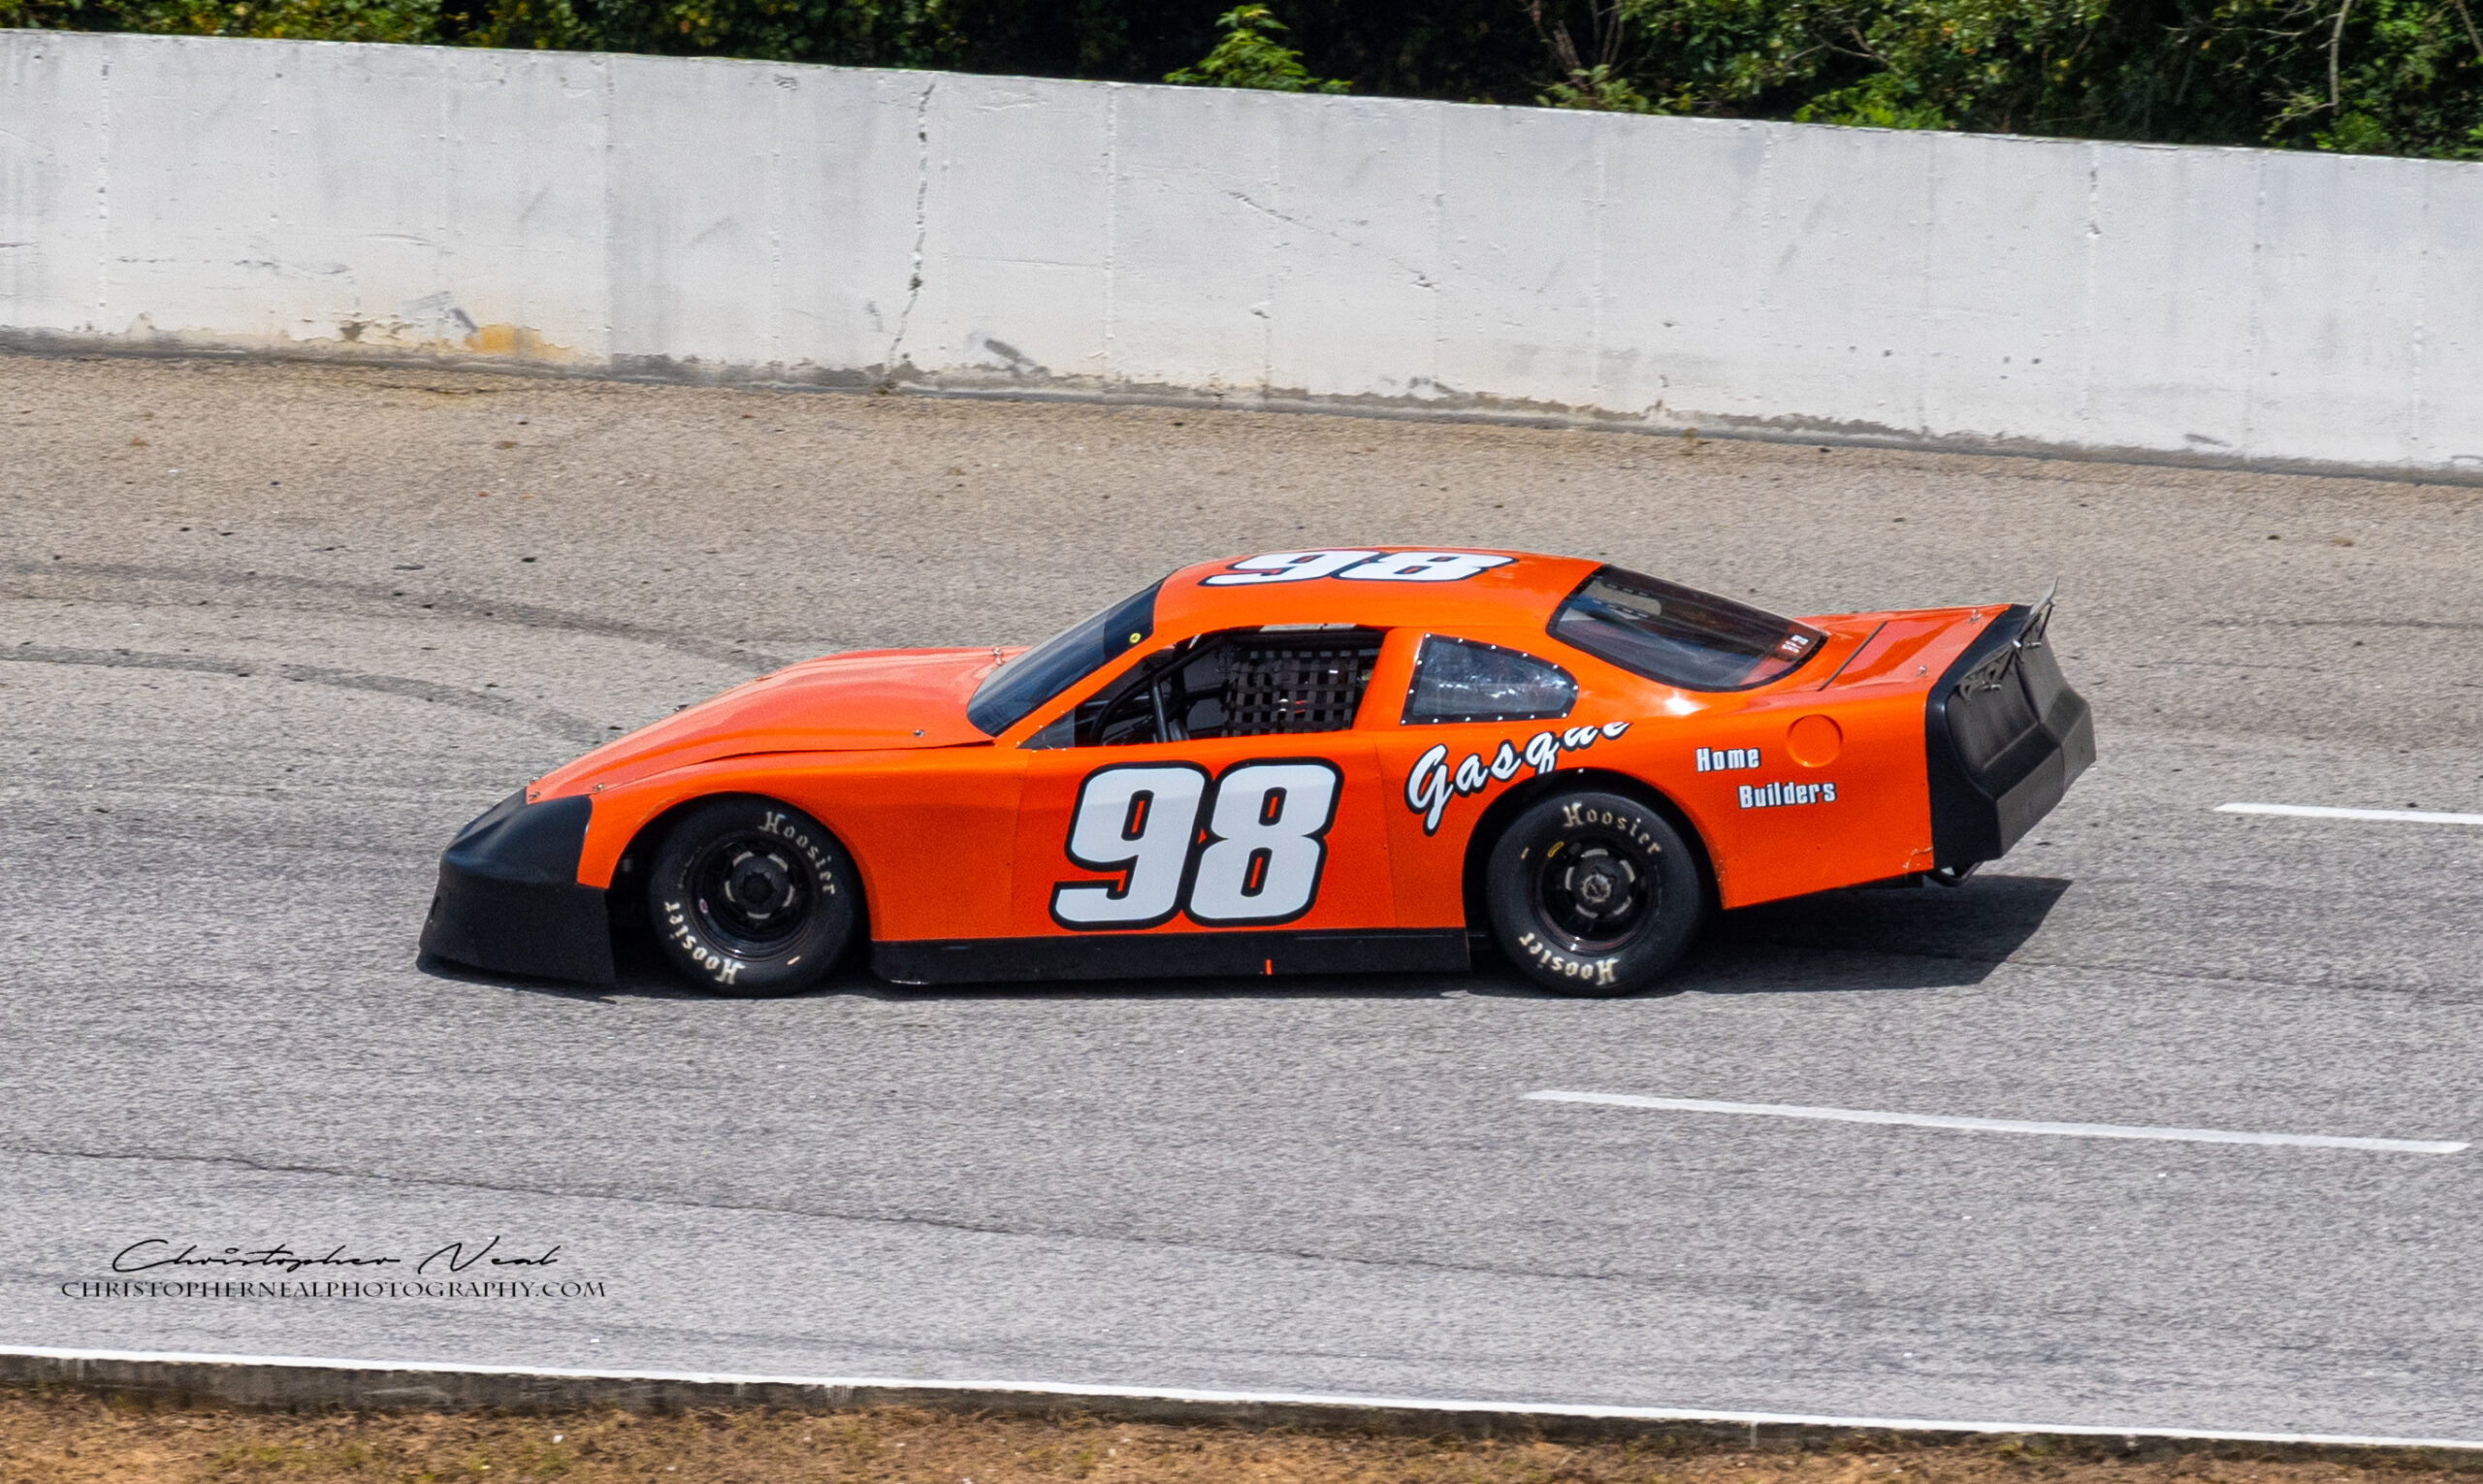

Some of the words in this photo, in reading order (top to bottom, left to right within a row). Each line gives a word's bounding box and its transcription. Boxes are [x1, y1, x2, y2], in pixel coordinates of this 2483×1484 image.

[1198, 549, 1519, 586] 98
[1694, 746, 1761, 773] Home
[1737, 781, 1837, 809] Builders
[758, 810, 836, 895] Hoosier
[1050, 758, 1342, 929] 98
[1562, 801, 1662, 855] Hoosier
[663, 899, 746, 985] Hoosier
[1518, 931, 1622, 986] Hoosier
